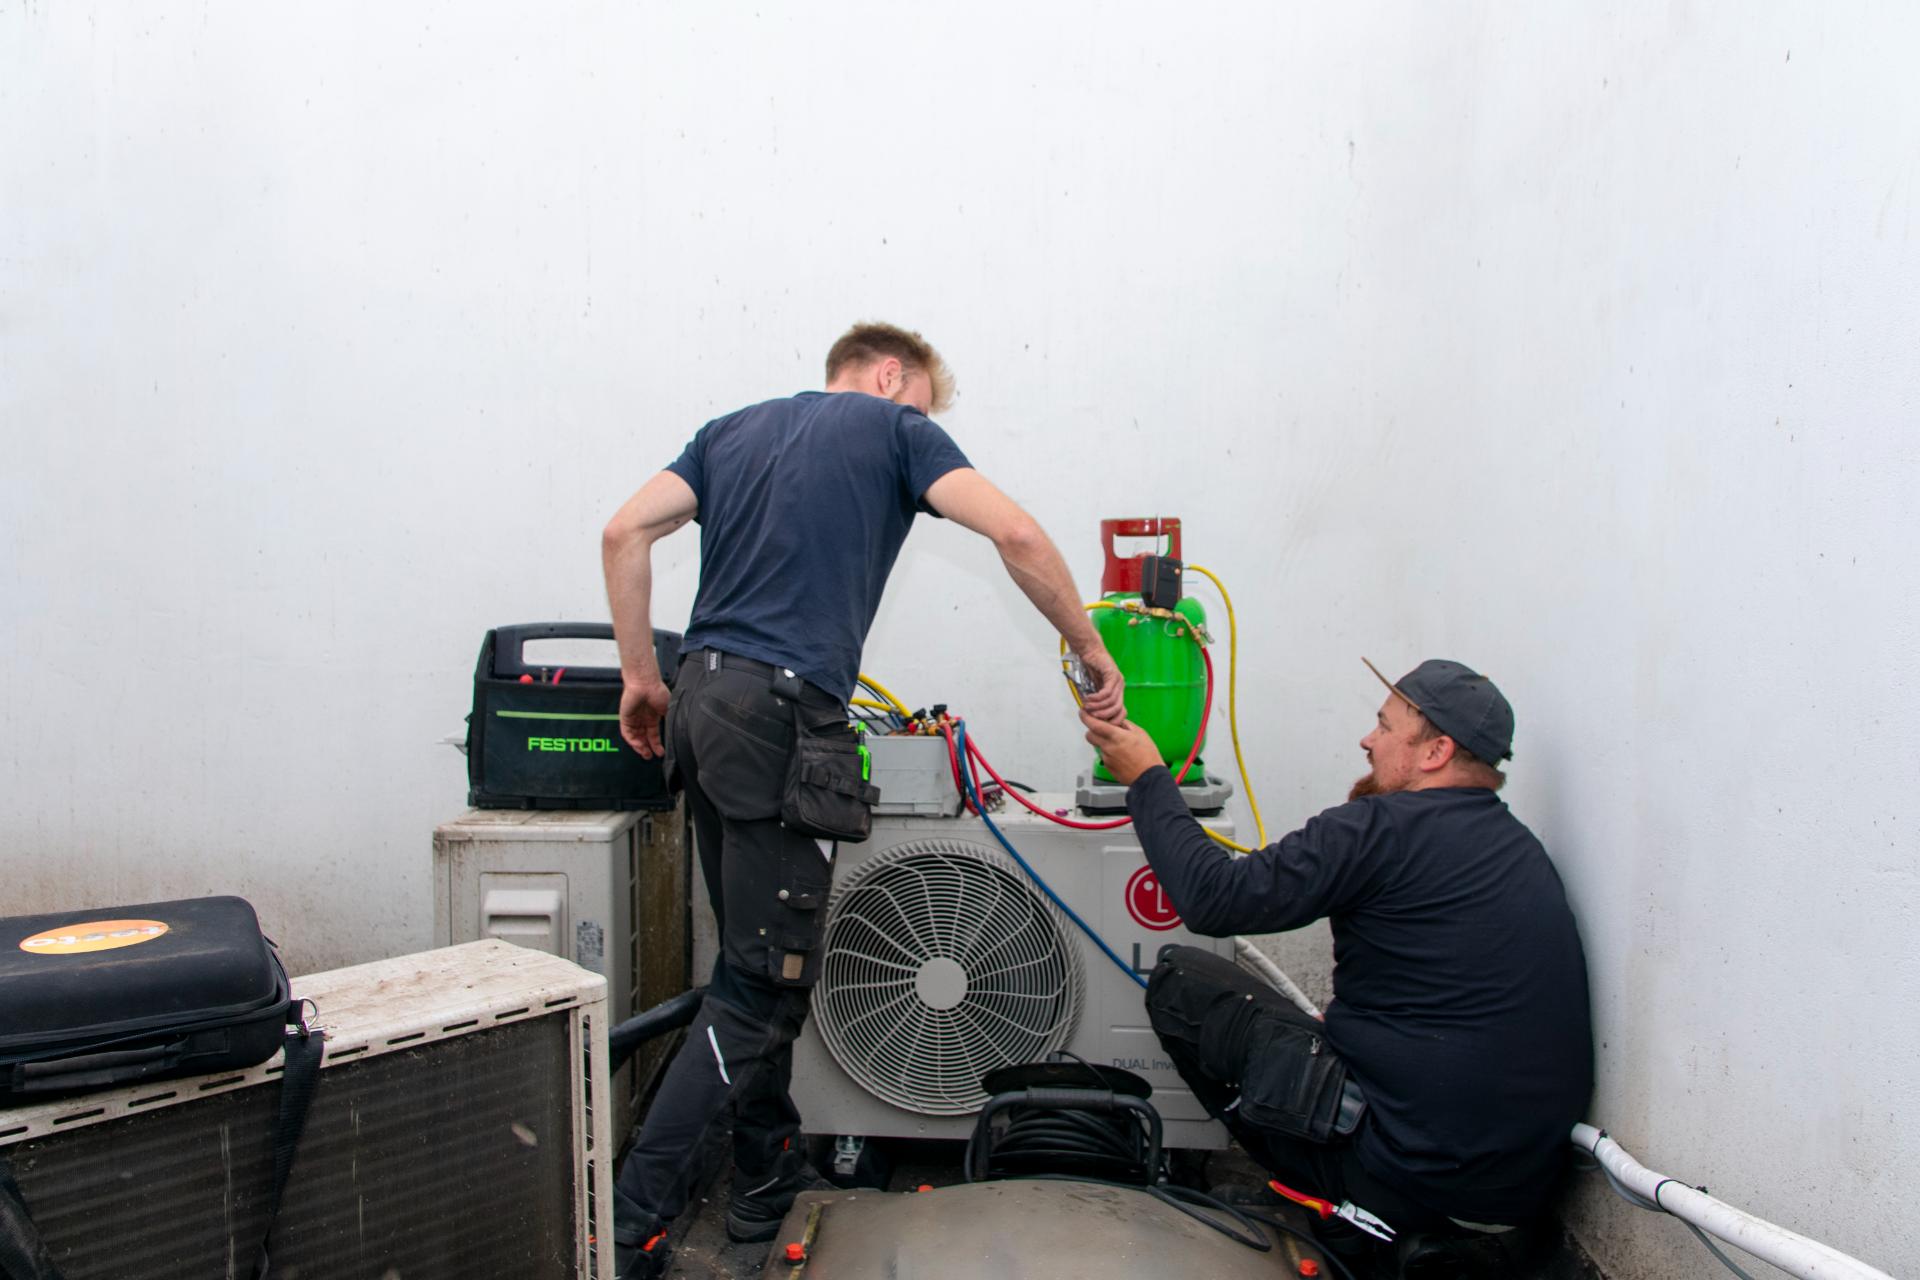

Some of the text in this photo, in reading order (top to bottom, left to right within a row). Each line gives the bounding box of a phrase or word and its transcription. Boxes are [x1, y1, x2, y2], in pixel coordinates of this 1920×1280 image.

[528, 736, 619, 752] FESTOOL
[1113, 1058, 1178, 1070] DUAL Inve
